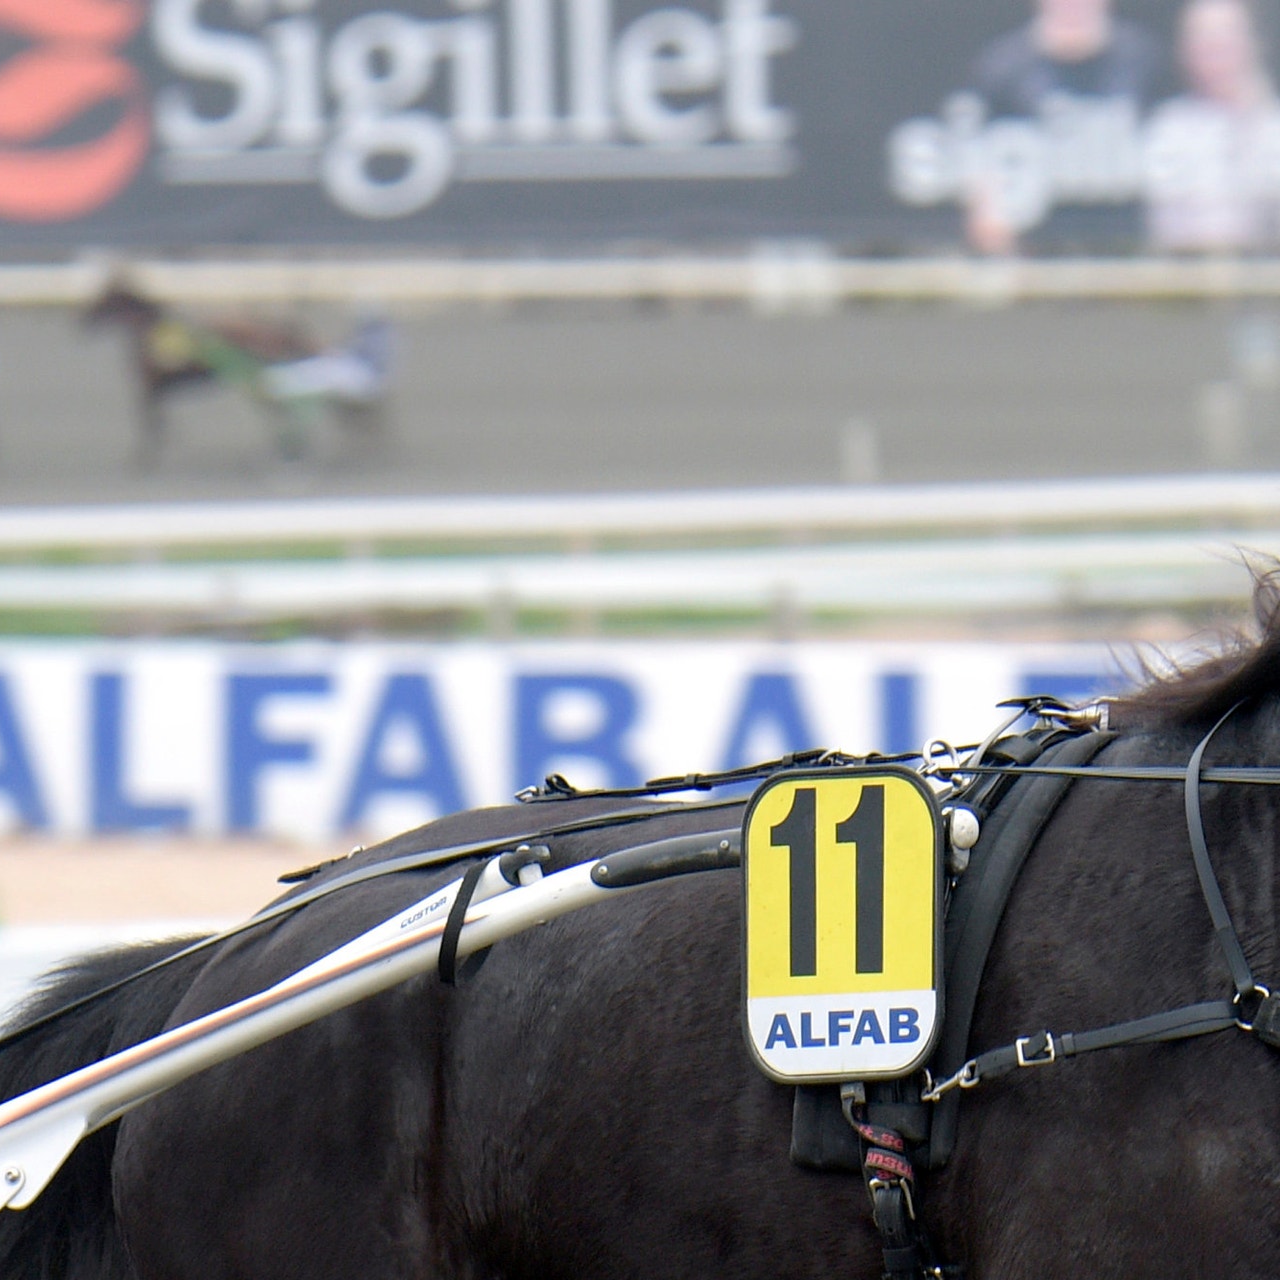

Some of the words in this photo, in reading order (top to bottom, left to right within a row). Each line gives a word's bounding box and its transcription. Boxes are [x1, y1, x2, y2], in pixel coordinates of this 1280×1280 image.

[152, 0, 798, 216] Sigillet
[400, 896, 448, 928] CUSTOM
[770, 784, 885, 977] 11
[765, 1007, 921, 1050] ALFAB
